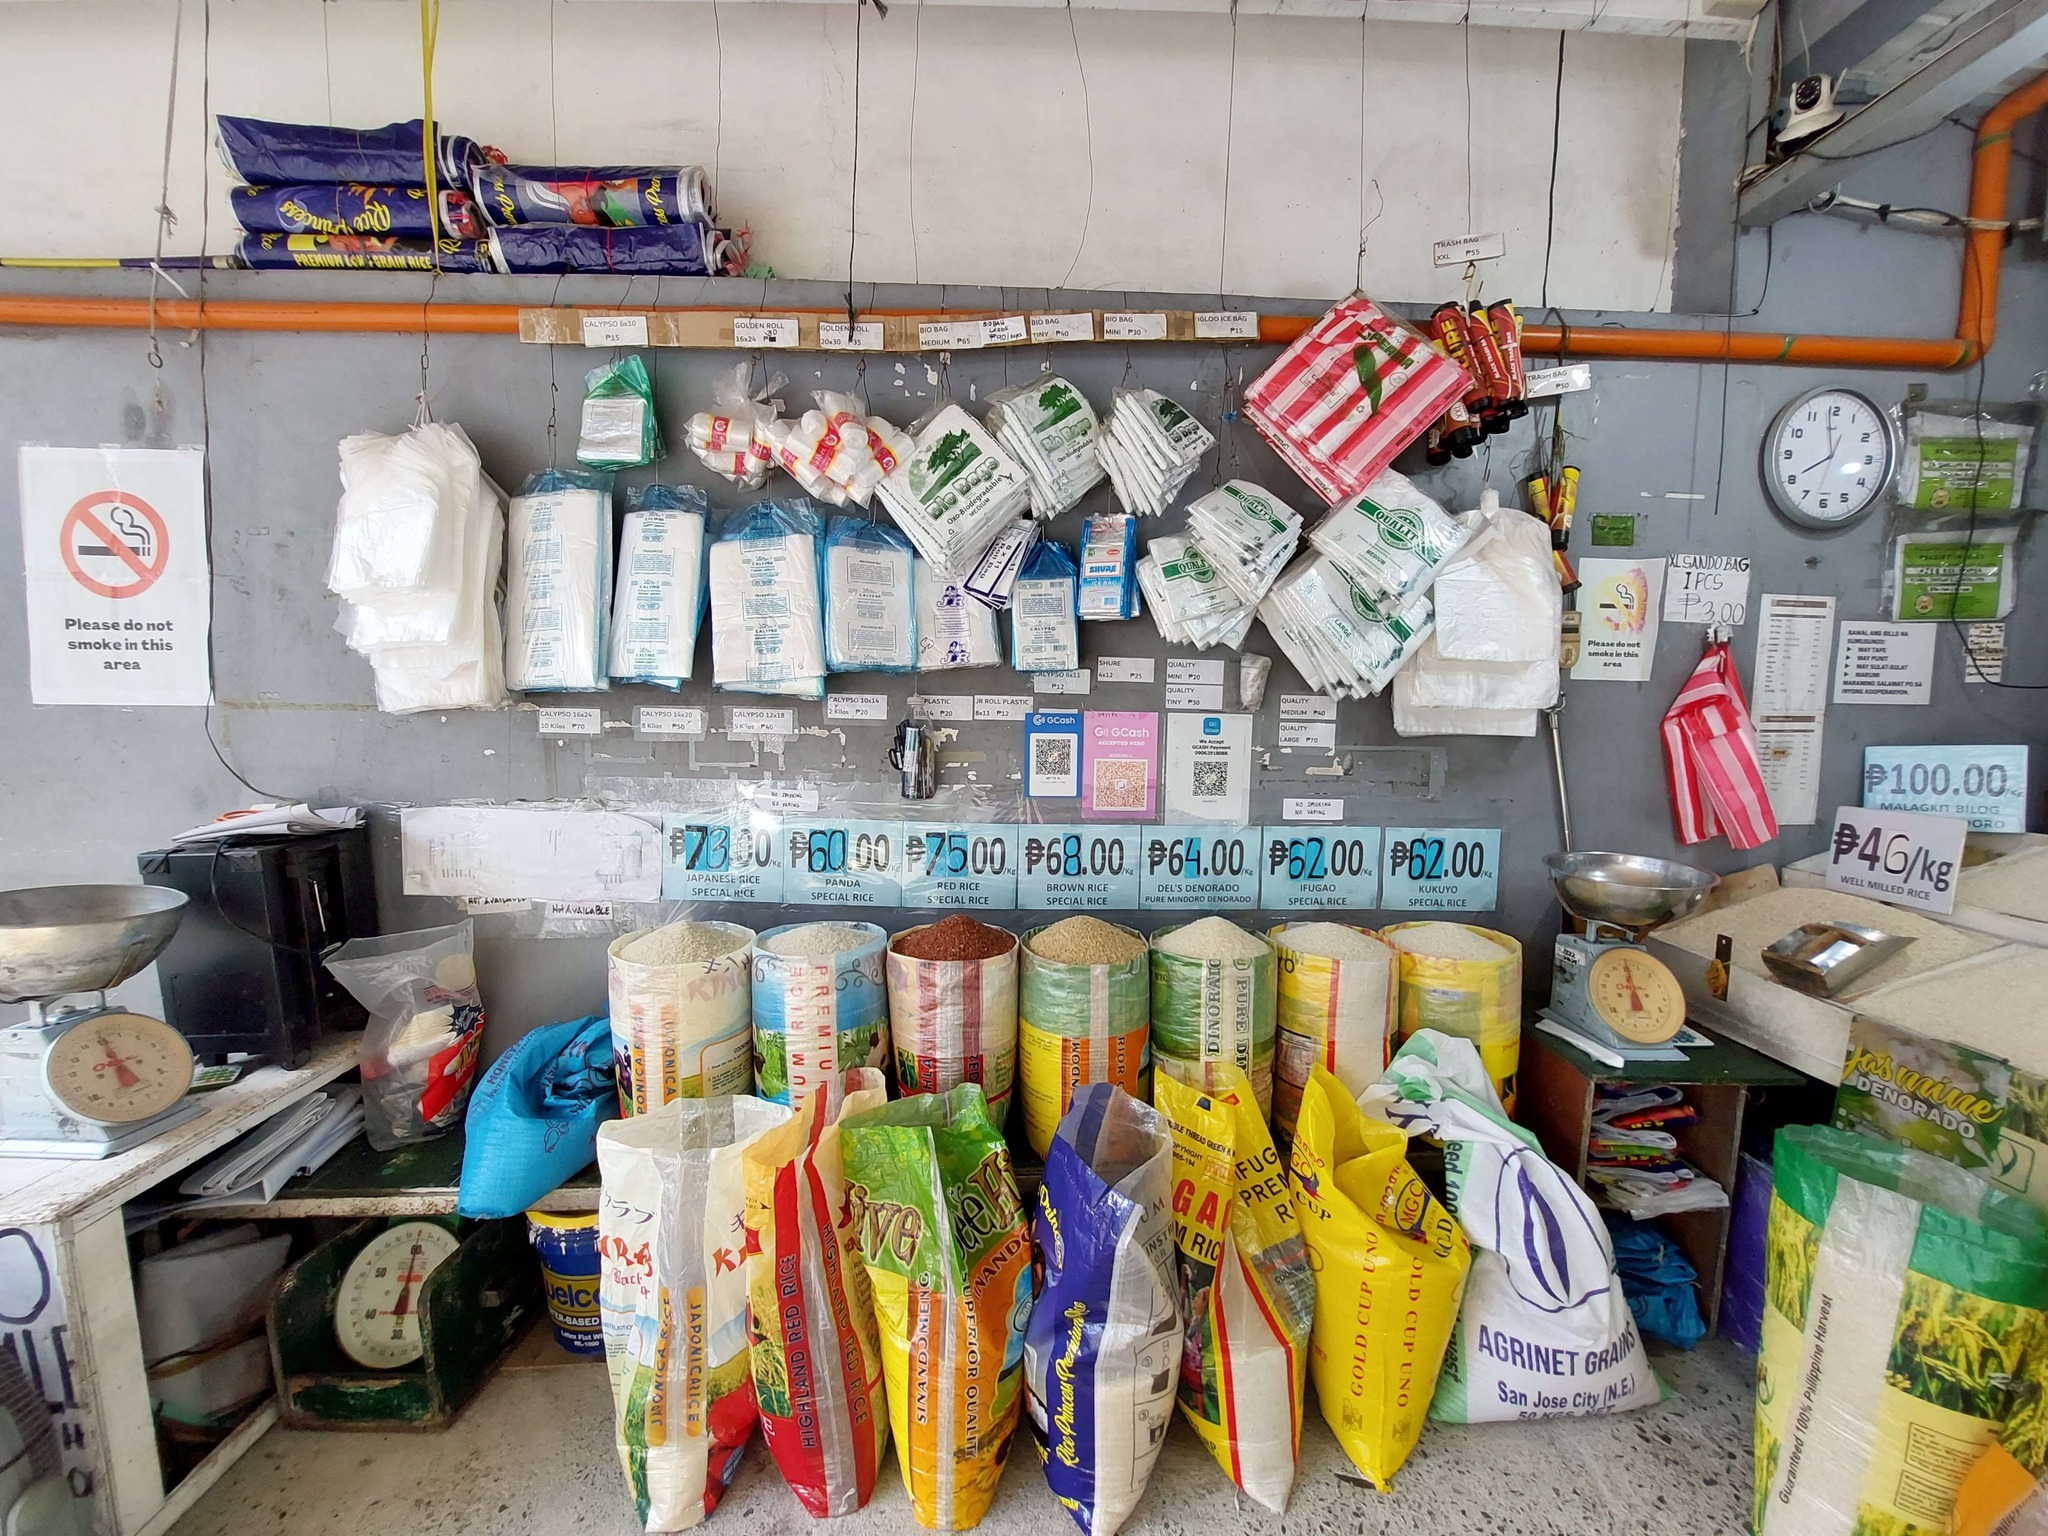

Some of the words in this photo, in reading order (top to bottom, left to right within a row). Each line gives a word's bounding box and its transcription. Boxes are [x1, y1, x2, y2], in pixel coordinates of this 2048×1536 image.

[1436, 240, 1461, 249] TRASH
[1463, 236, 1479, 245] BAG
[1436, 253, 1450, 261] XXL
[1465, 249, 1480, 257] ₱55
[294, 254, 346, 267] PREMIUM
[374, 255, 408, 269] GRAIN
[409, 256, 433, 269] RICE
[584, 320, 618, 328] CALYPSO
[735, 322, 764, 330] GOLDEN
[933, 326, 948, 334] BAG
[736, 335, 756, 343] 16x24
[921, 339, 950, 347] MEDIUM
[1807, 411, 1817, 423] 11
[1791, 429, 1803, 439] 10
[1861, 433, 1870, 443] 2
[1787, 475, 1796, 485] 8
[925, 490, 958, 522] Bio
[954, 456, 1000, 498] Bags
[946, 475, 1003, 525] Oxo-Biodegradable
[968, 498, 991, 518] MEDIUM
[1237, 493, 1276, 523] QUALITY
[1365, 548, 1386, 566] MEDIUM
[1669, 554, 1680, 568] XL
[1683, 555, 1722, 569] SANDO
[1724, 557, 1749, 572] BAG
[1088, 564, 1117, 574] SHURE
[1695, 573, 1723, 590] PCS
[64, 618, 120, 631] Please
[124, 618, 143, 631] do
[146, 619, 173, 631] not
[1334, 617, 1352, 640] LARGE
[67, 639, 122, 651] smoke
[125, 639, 138, 651] in
[141, 639, 173, 651] this
[1588, 640, 1614, 648] Please
[1616, 640, 1626, 648] do
[1588, 650, 1614, 658] smoke
[1615, 650, 1622, 658] in
[1623, 650, 1639, 658] this
[103, 660, 141, 670] area
[1167, 687, 1195, 695] QUALITY
[828, 696, 859, 704] CALYPSO
[1281, 697, 1309, 705] QUALITY
[765, 711, 785, 719] 12x18
[1047, 716, 1076, 725] GCash
[1111, 728, 1149, 738] GCash
[1280, 736, 1300, 744] LARGE
[1880, 802, 1950, 813] MALAGKIT
[1956, 804, 1999, 815] BILOG
[1833, 823, 1953, 892] ₱46/kg
[686, 874, 737, 884] JAPANESE
[739, 875, 761, 885] RICE
[825, 878, 861, 888] PANDA
[937, 881, 957, 891] RED
[959, 882, 981, 892] RICE
[1046, 883, 1086, 892] BROWN
[1087, 883, 1108, 892] RICE
[1158, 883, 1183, 892] DEL'S
[1185, 883, 1240, 893] DENORADO
[1300, 883, 1336, 893] IFUGAO
[1418, 885, 1458, 895] KUKUYO
[1840, 875, 1865, 888] WELL
[1868, 880, 1905, 895] MILLED
[1907, 888, 1931, 900] RICE
[691, 888, 732, 898] SPECIAL
[734, 888, 756, 898] RICE
[811, 891, 850, 902] SPECIAL
[852, 892, 874, 902] RICE
[1145, 895, 1165, 903] PURE
[1167, 895, 1205, 903] MINDORO
[1207, 895, 1251, 903] DENORADO
[927, 894, 966, 904] SPECIAL
[968, 895, 990, 905] RICE
[1046, 897, 1085, 906] SPECIAL
[1087, 897, 1108, 906] RICE
[1288, 897, 1325, 906] SPECIAL
[1327, 897, 1347, 906] RICE
[1408, 898, 1445, 907] SPECIAL
[1447, 898, 1467, 908] RICE
[1235, 975, 1249, 1035] PURE
[1857, 1076, 1976, 1139] DENORADO
[1296, 1191, 1332, 1222] CUP
[1361, 1231, 1378, 1274] UNO
[781, 1254, 796, 1297] RICE
[823, 1223, 848, 1329] HIGHLAND
[1357, 1281, 1375, 1326] CUP
[783, 1304, 802, 1343] RED
[960, 1271, 981, 1380] SUPERIOR
[843, 1336, 860, 1372] RED
[916, 1271, 931, 1425] SINANDOMENG
[1478, 1324, 1579, 1376] AGRINET
[1584, 1320, 1635, 1376] GRAINS
[1350, 1333, 1368, 1397] GOLD
[1498, 1380, 1528, 1406] San
[1533, 1391, 1568, 1409] Jose
[1572, 1388, 1600, 1410] City
[1604, 1374, 1635, 1405] (N.E.)
[791, 1350, 816, 1448] HIGHLAND
[849, 1377, 867, 1424] RICE
[1778, 1435, 1804, 1504] Guaranteed
[1795, 1404, 1813, 1434] 100%
[1813, 1294, 1833, 1343] Harvest
[1054, 1379, 1077, 1437] Princess
[964, 1384, 981, 1458] QUALITY
[1055, 1434, 1079, 1467] Rice
